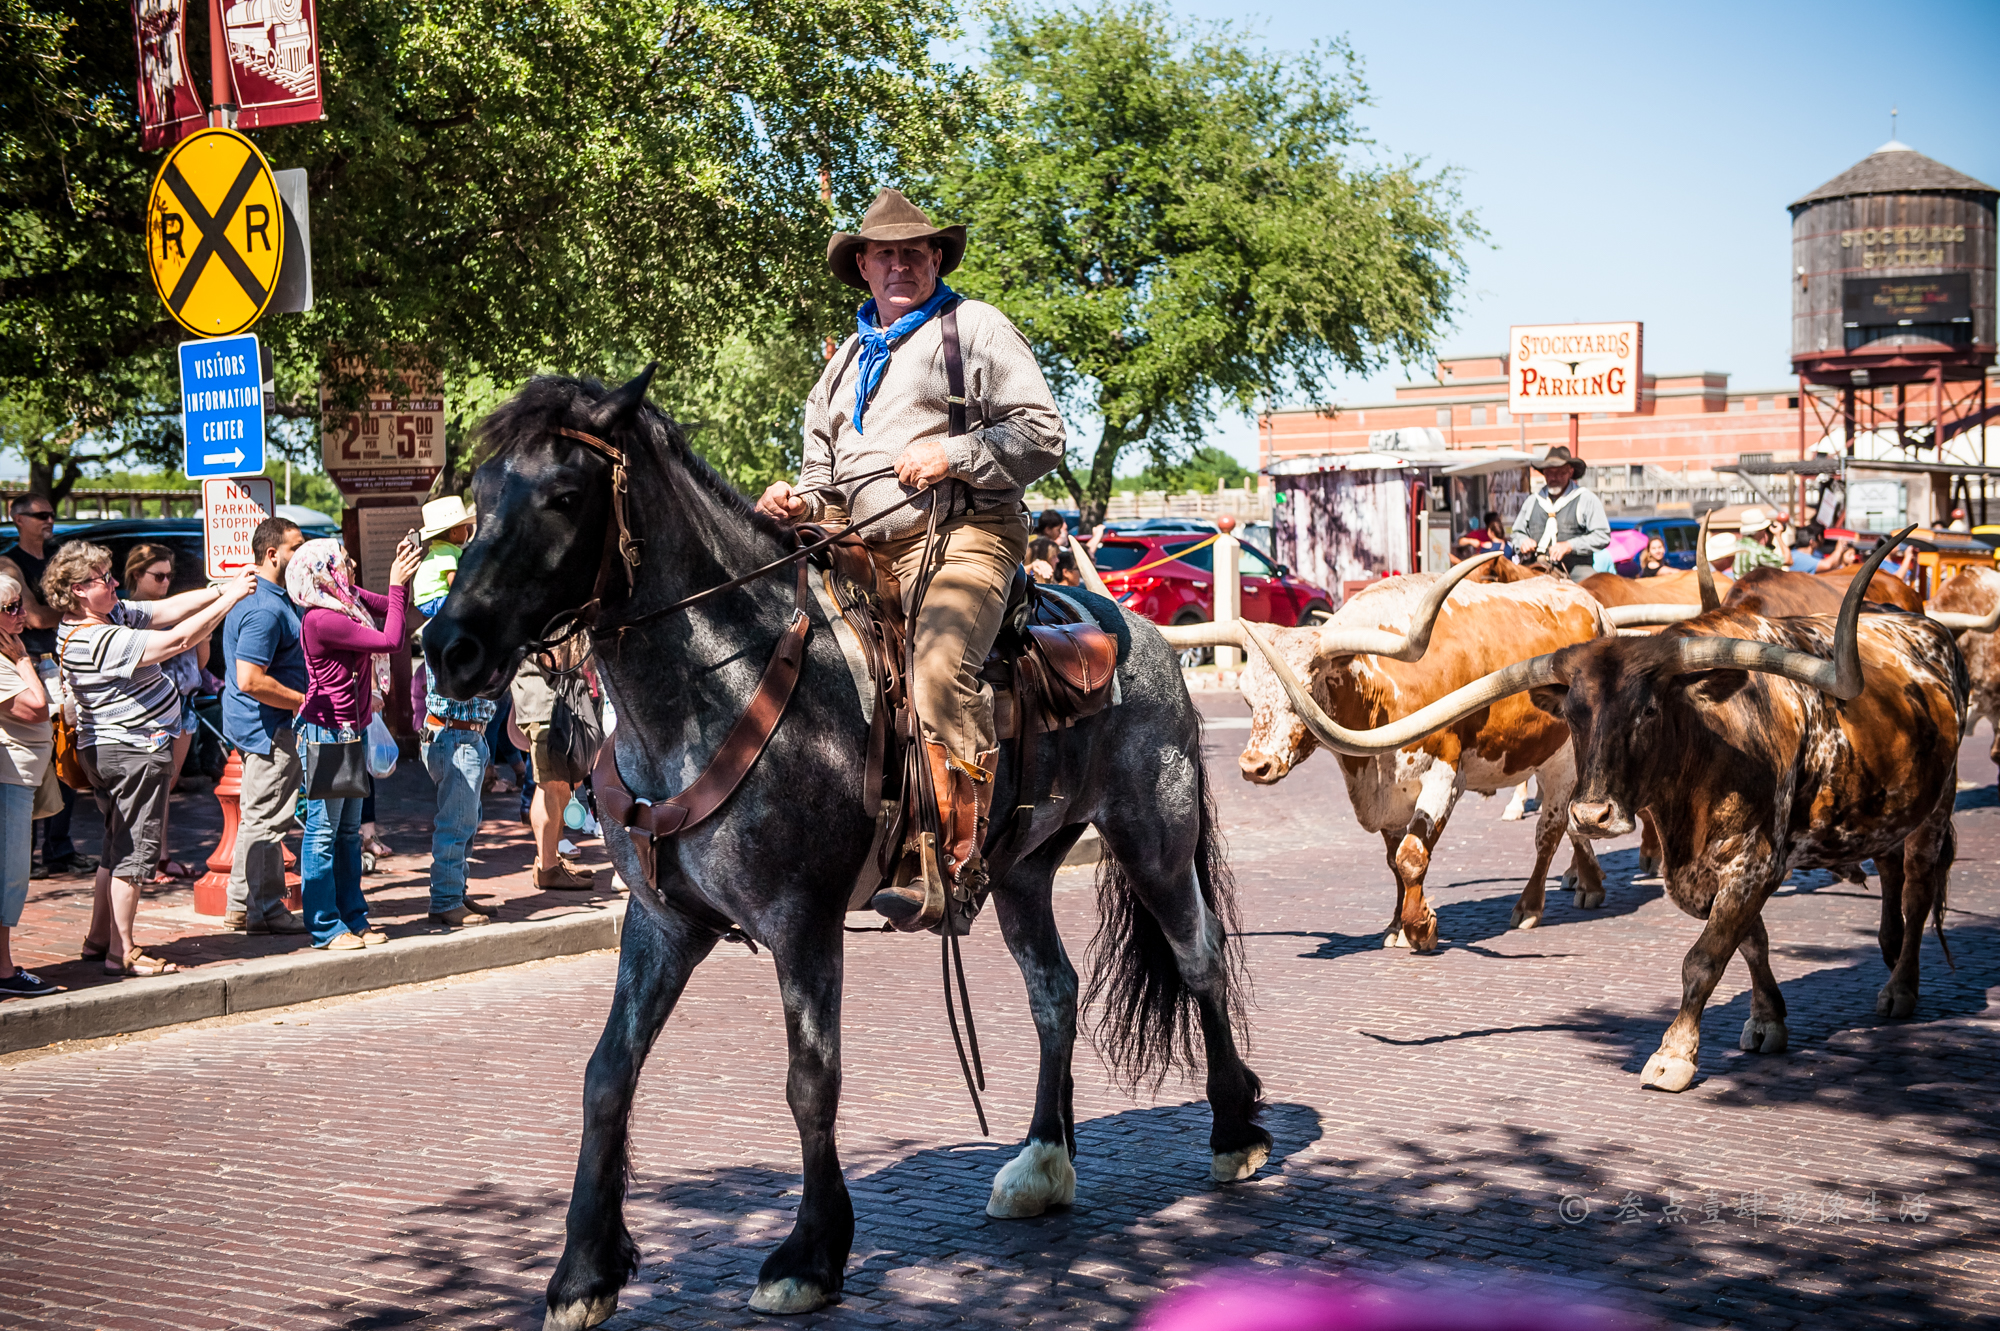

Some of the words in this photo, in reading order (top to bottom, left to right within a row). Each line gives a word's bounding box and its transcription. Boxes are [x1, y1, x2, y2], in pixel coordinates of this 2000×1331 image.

[161, 213, 185, 260] R
[246, 204, 271, 252] R
[1841, 225, 1965, 247] STOCKYARDS
[1863, 249, 1943, 269] STATION
[1519, 332, 1629, 361] STOCKYARDS
[194, 354, 246, 380] VISITORS
[1520, 367, 1626, 397] PARKING
[187, 386, 259, 413] INFORMATION
[203, 418, 244, 442] CENTER
[365, 440, 377, 449] PER
[418, 440, 431, 448] ALL
[418, 450, 432, 458] DAY
[226, 484, 251, 499] NO
[215, 503, 265, 515] PARKING
[212, 517, 267, 529] STOPPIN
[233, 531, 249, 542] OR
